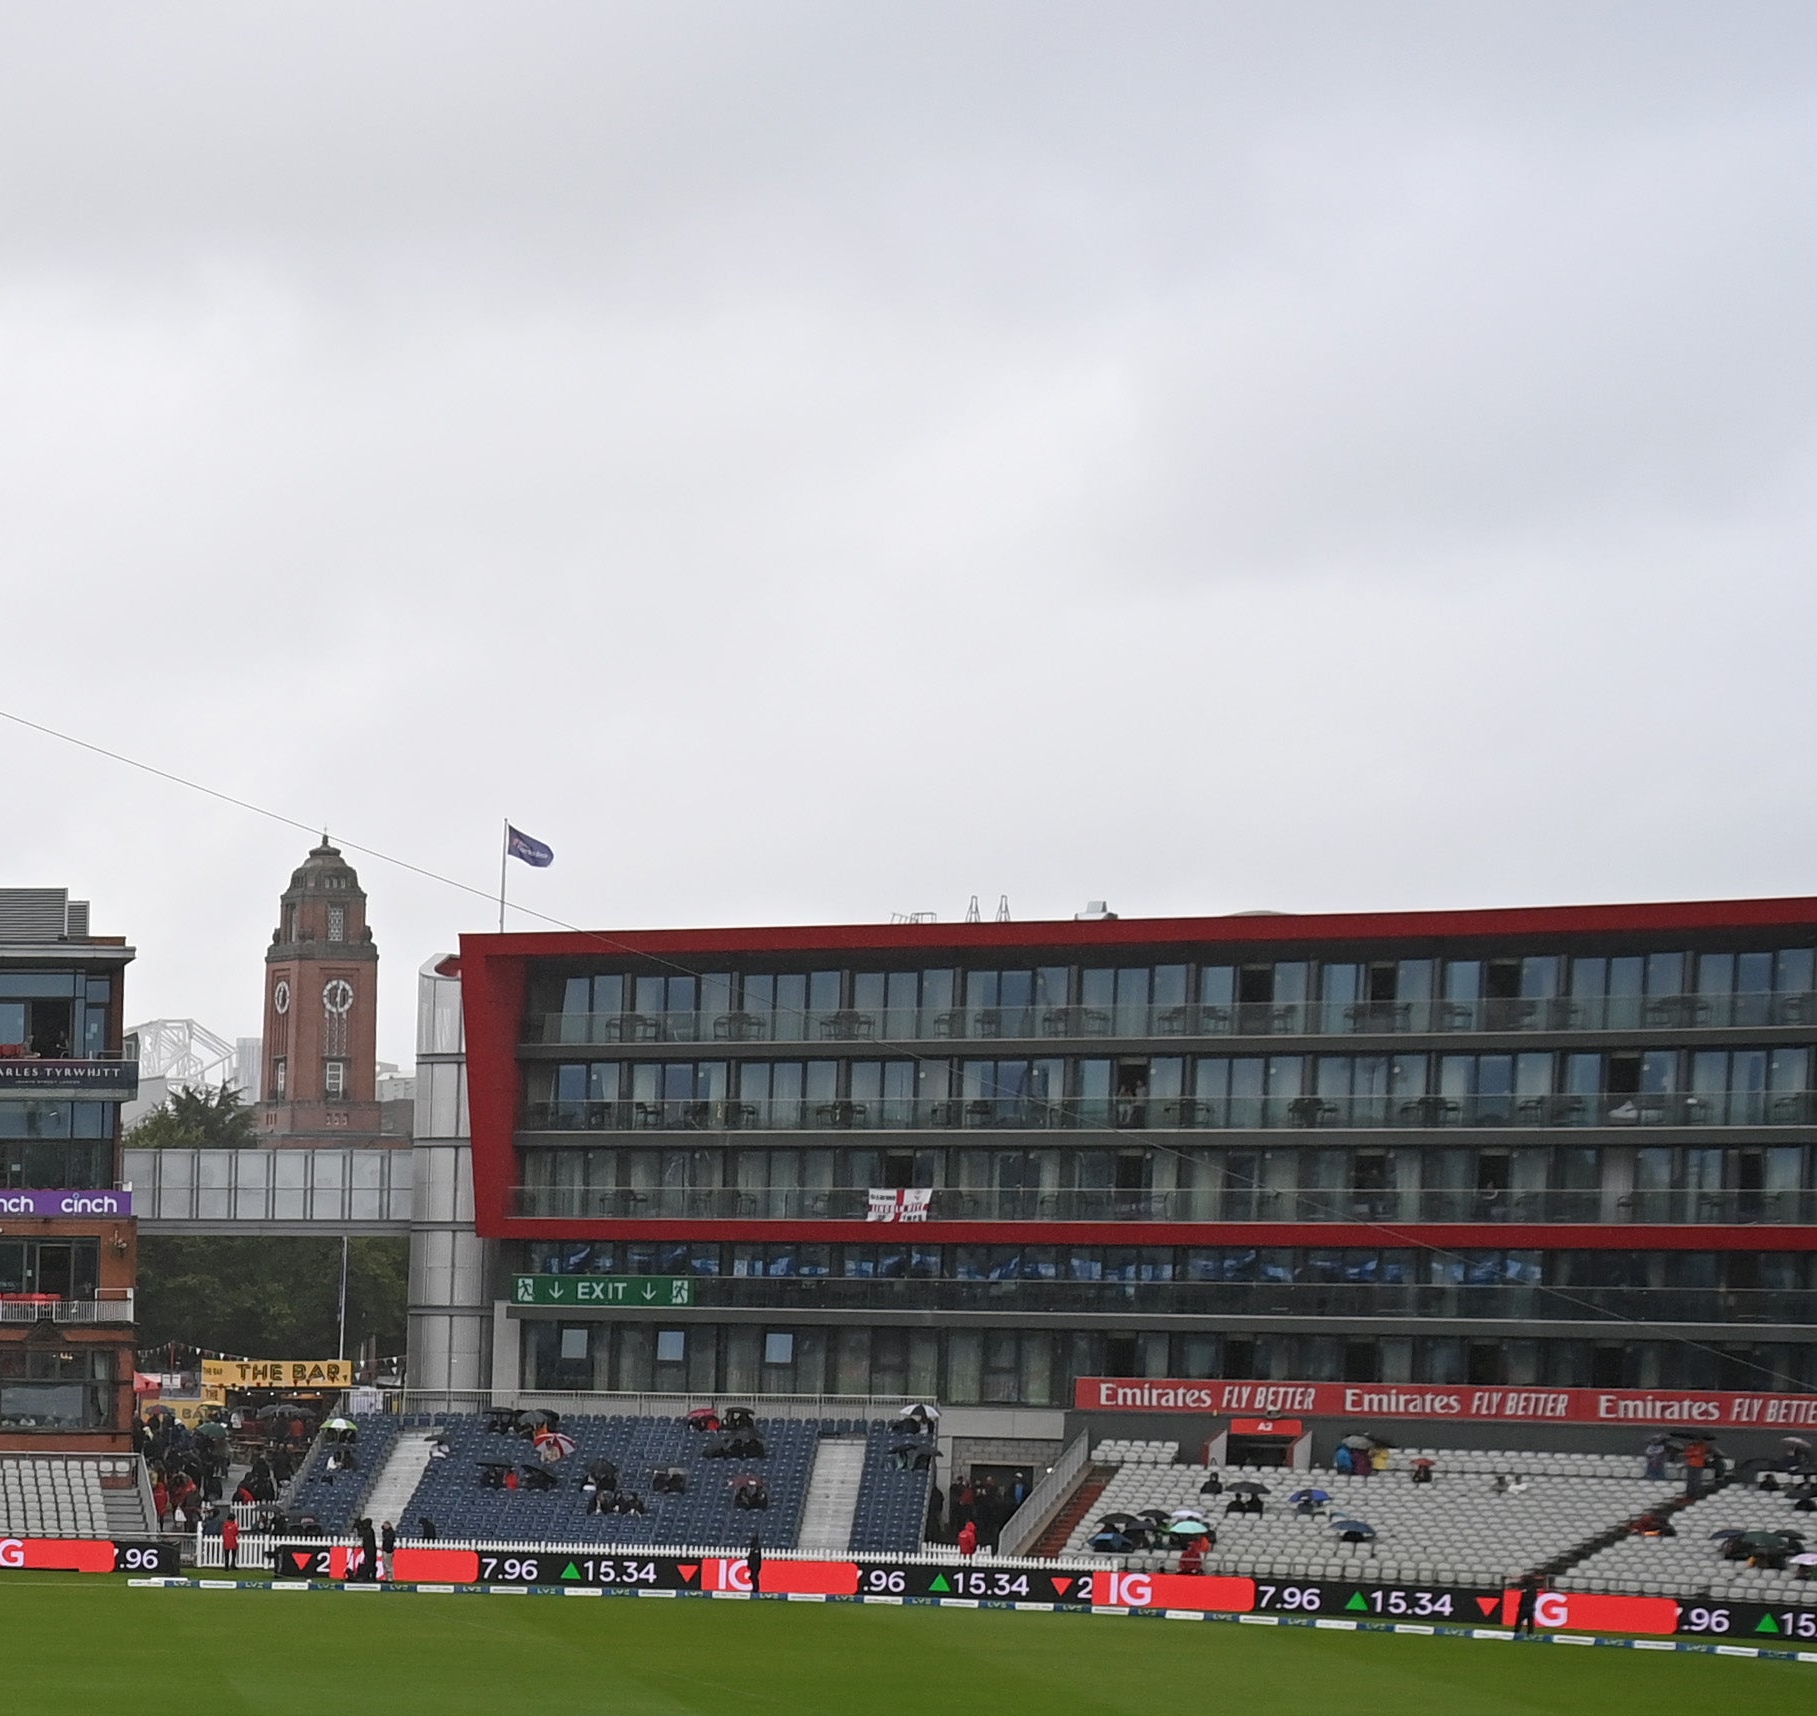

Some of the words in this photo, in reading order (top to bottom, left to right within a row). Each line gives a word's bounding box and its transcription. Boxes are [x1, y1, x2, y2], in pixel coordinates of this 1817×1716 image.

[46, 1068, 121, 1078] TYRWHITT
[61, 1192, 117, 1214] cinch
[577, 1282, 627, 1300] EXIT
[236, 1364, 283, 1382] THE
[292, 1364, 340, 1382] BAR
[1099, 1382, 1213, 1408] Emirates
[1221, 1386, 1252, 1409] FLY
[1254, 1387, 1315, 1410] BETTER
[1345, 1389, 1461, 1414] Emirates
[1471, 1392, 1502, 1416] FLY
[1504, 1392, 1569, 1417] BETTER
[1599, 1396, 1720, 1421] Emirates
[1731, 1399, 1763, 1423] FLY
[1765, 1400, 1817, 1424] BETTE
[481, 1558, 538, 1580] 7.96
[583, 1561, 657, 1583] 15.34
[953, 1573, 1029, 1596] 15.34
[1109, 1573, 1152, 1606] IG
[1258, 1586, 1321, 1610] 7.96
[1370, 1592, 1453, 1617] 15.34
